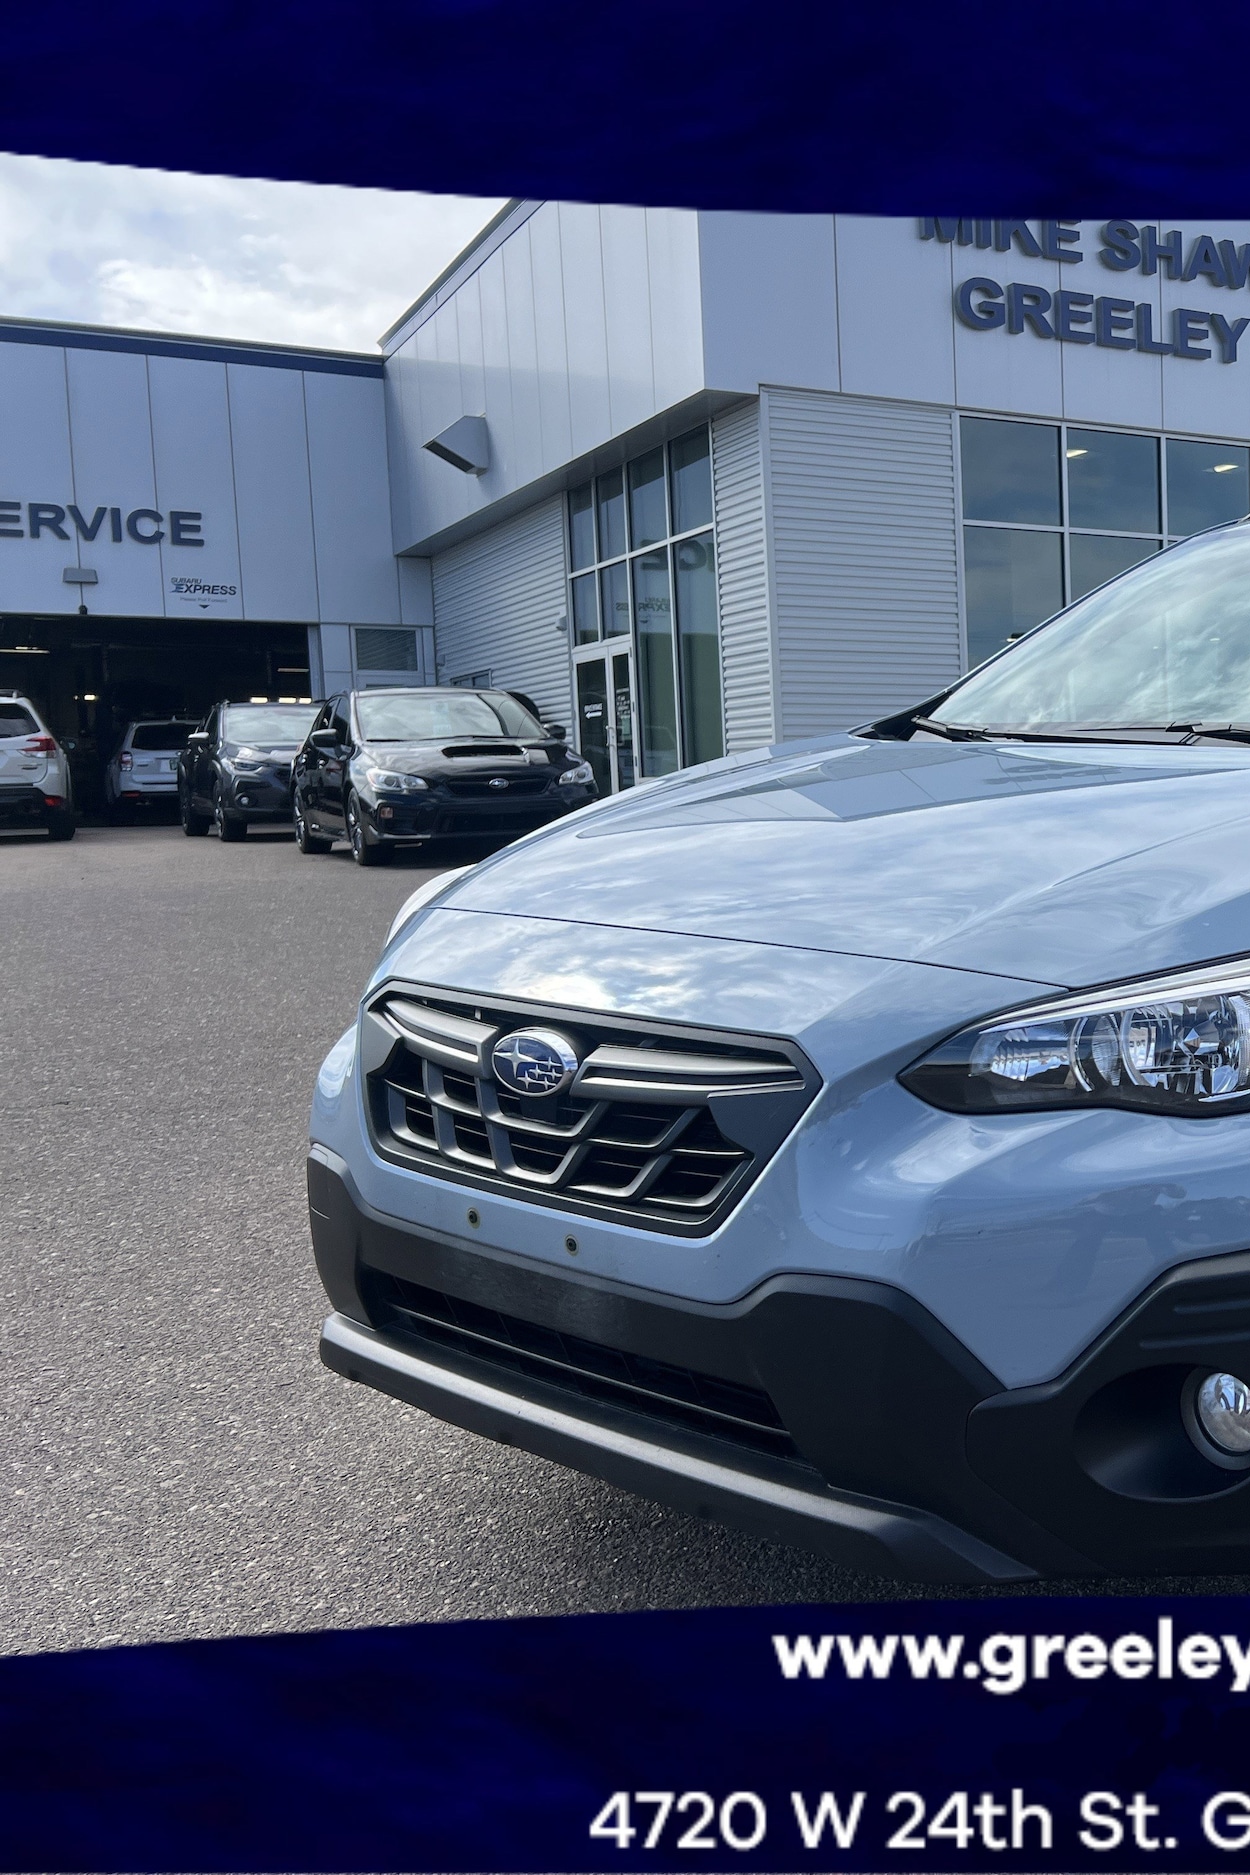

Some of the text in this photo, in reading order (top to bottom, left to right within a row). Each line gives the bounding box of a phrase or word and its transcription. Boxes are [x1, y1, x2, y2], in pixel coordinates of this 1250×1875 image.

[954, 276, 1250, 364] GREELEY
[170, 577, 203, 585] SUBARU
[170, 583, 238, 596] EXPRESS
